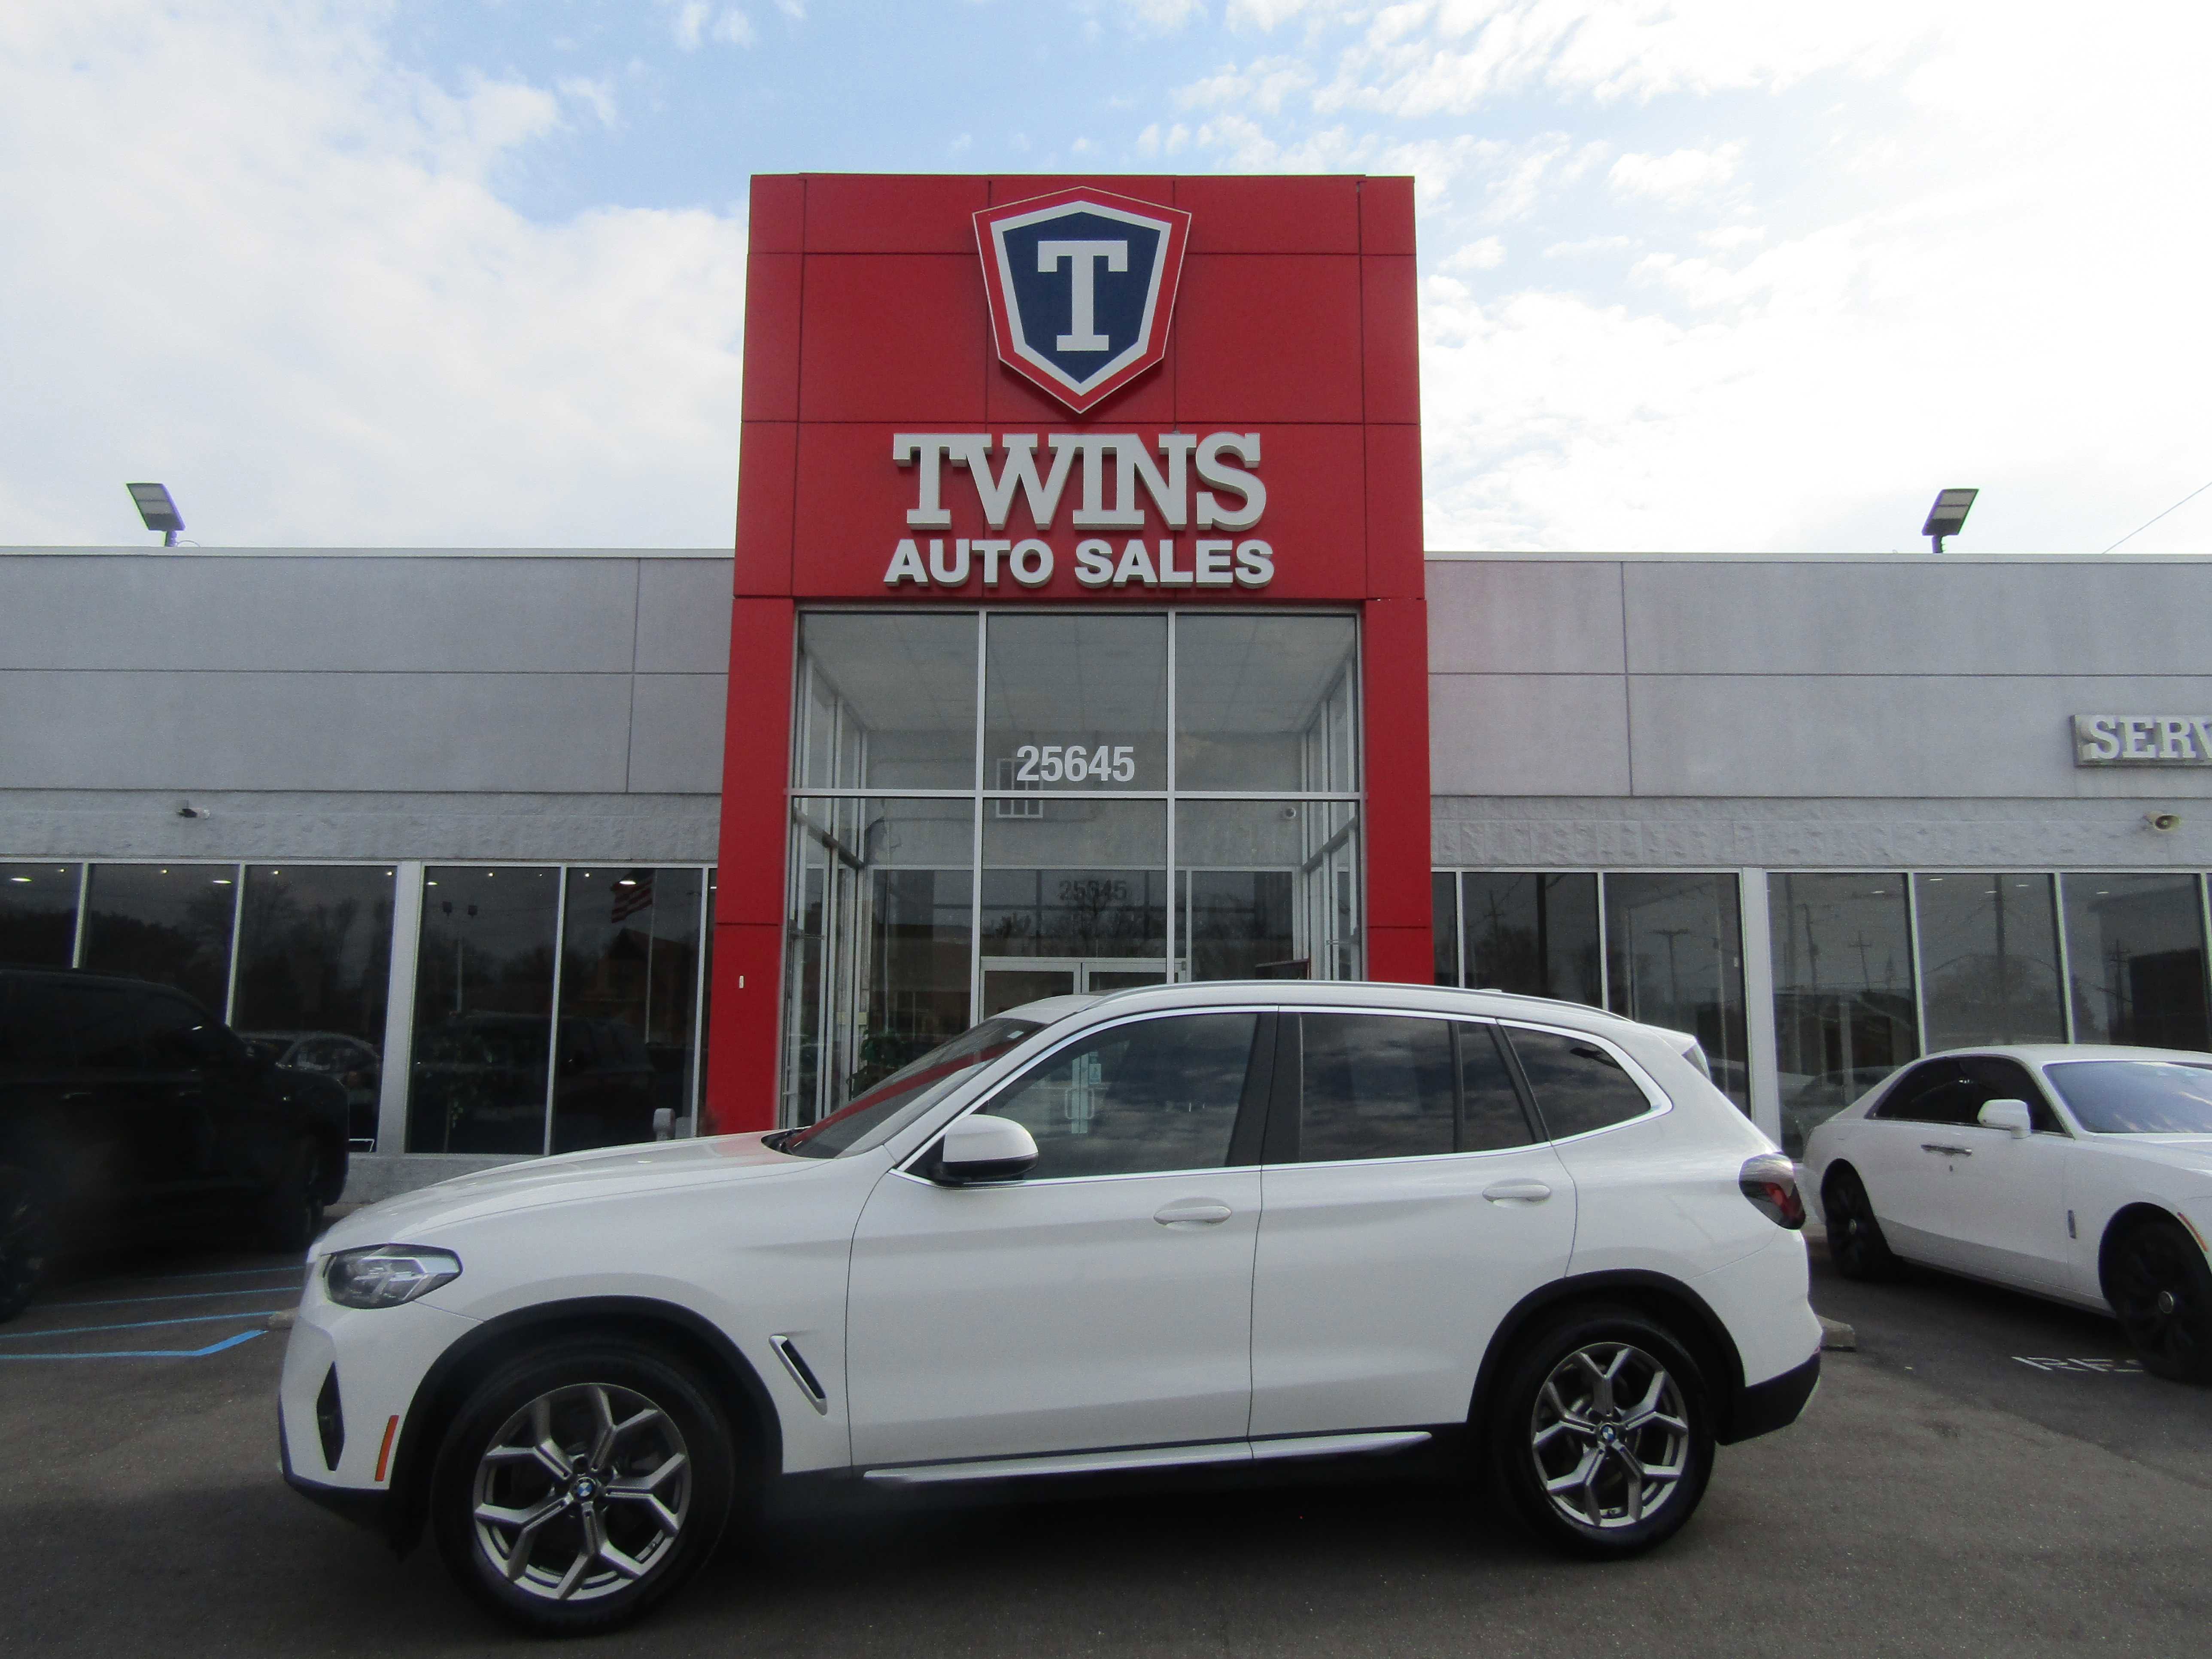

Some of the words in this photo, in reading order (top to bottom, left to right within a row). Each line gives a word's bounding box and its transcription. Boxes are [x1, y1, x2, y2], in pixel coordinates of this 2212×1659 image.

[1037, 240, 1128, 351] T
[893, 431, 1267, 532] TWINS
[883, 538, 1054, 588] AUTO
[1074, 538, 1275, 589] SALES
[1016, 745, 1135, 782] 25645
